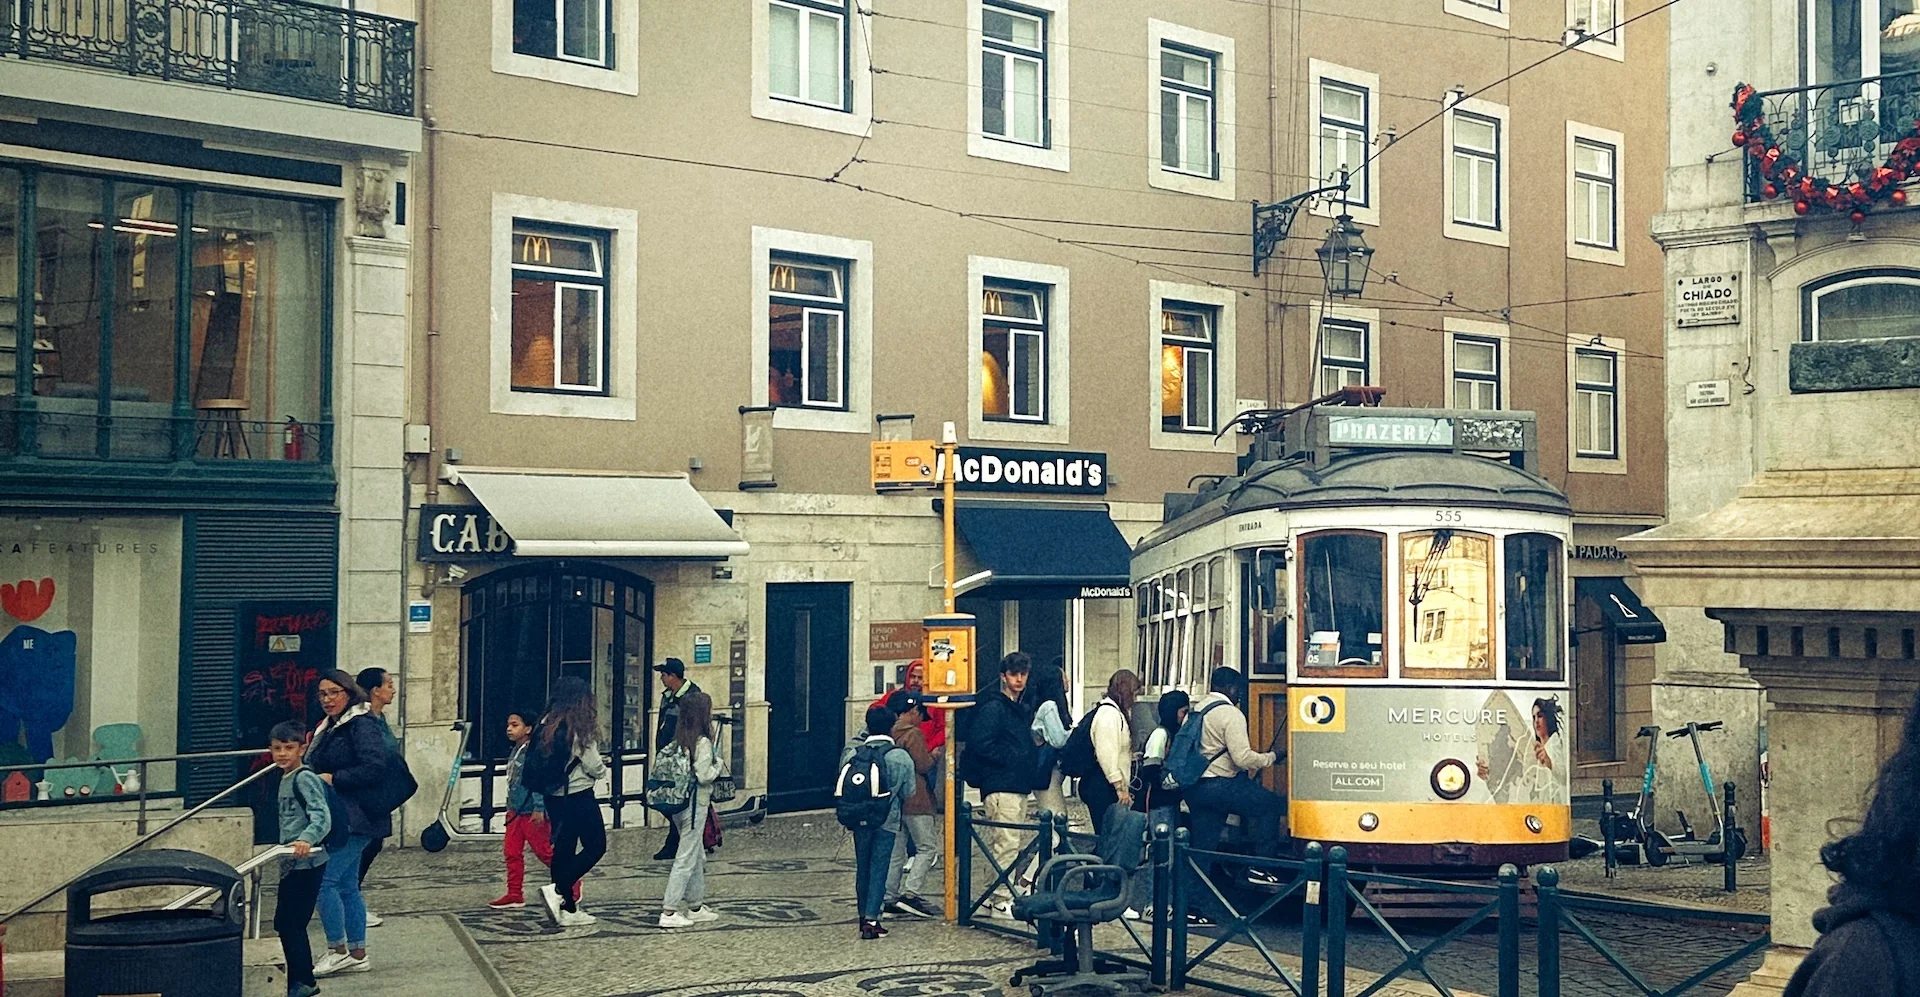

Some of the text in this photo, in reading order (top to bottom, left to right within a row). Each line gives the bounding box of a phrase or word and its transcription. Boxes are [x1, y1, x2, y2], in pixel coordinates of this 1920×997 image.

[1692, 276, 1722, 285] LARGO
[1683, 288, 1732, 301] CHIADO
[1336, 421, 1442, 443] PRAZERES
[936, 453, 1102, 487] McDonald's
[1435, 511, 1462, 522] 555
[429, 513, 516, 553] CAB
[1081, 586, 1131, 598] McDonald's
[1307, 654, 1320, 664] 05
[1388, 707, 1507, 725] MERCURE
[1422, 732, 1477, 743] HOTELS
[1312, 759, 1349, 769] Reserve
[1359, 762, 1378, 770] seu
[1379, 761, 1406, 771] hotel
[1334, 777, 1380, 786] ALL.COM
